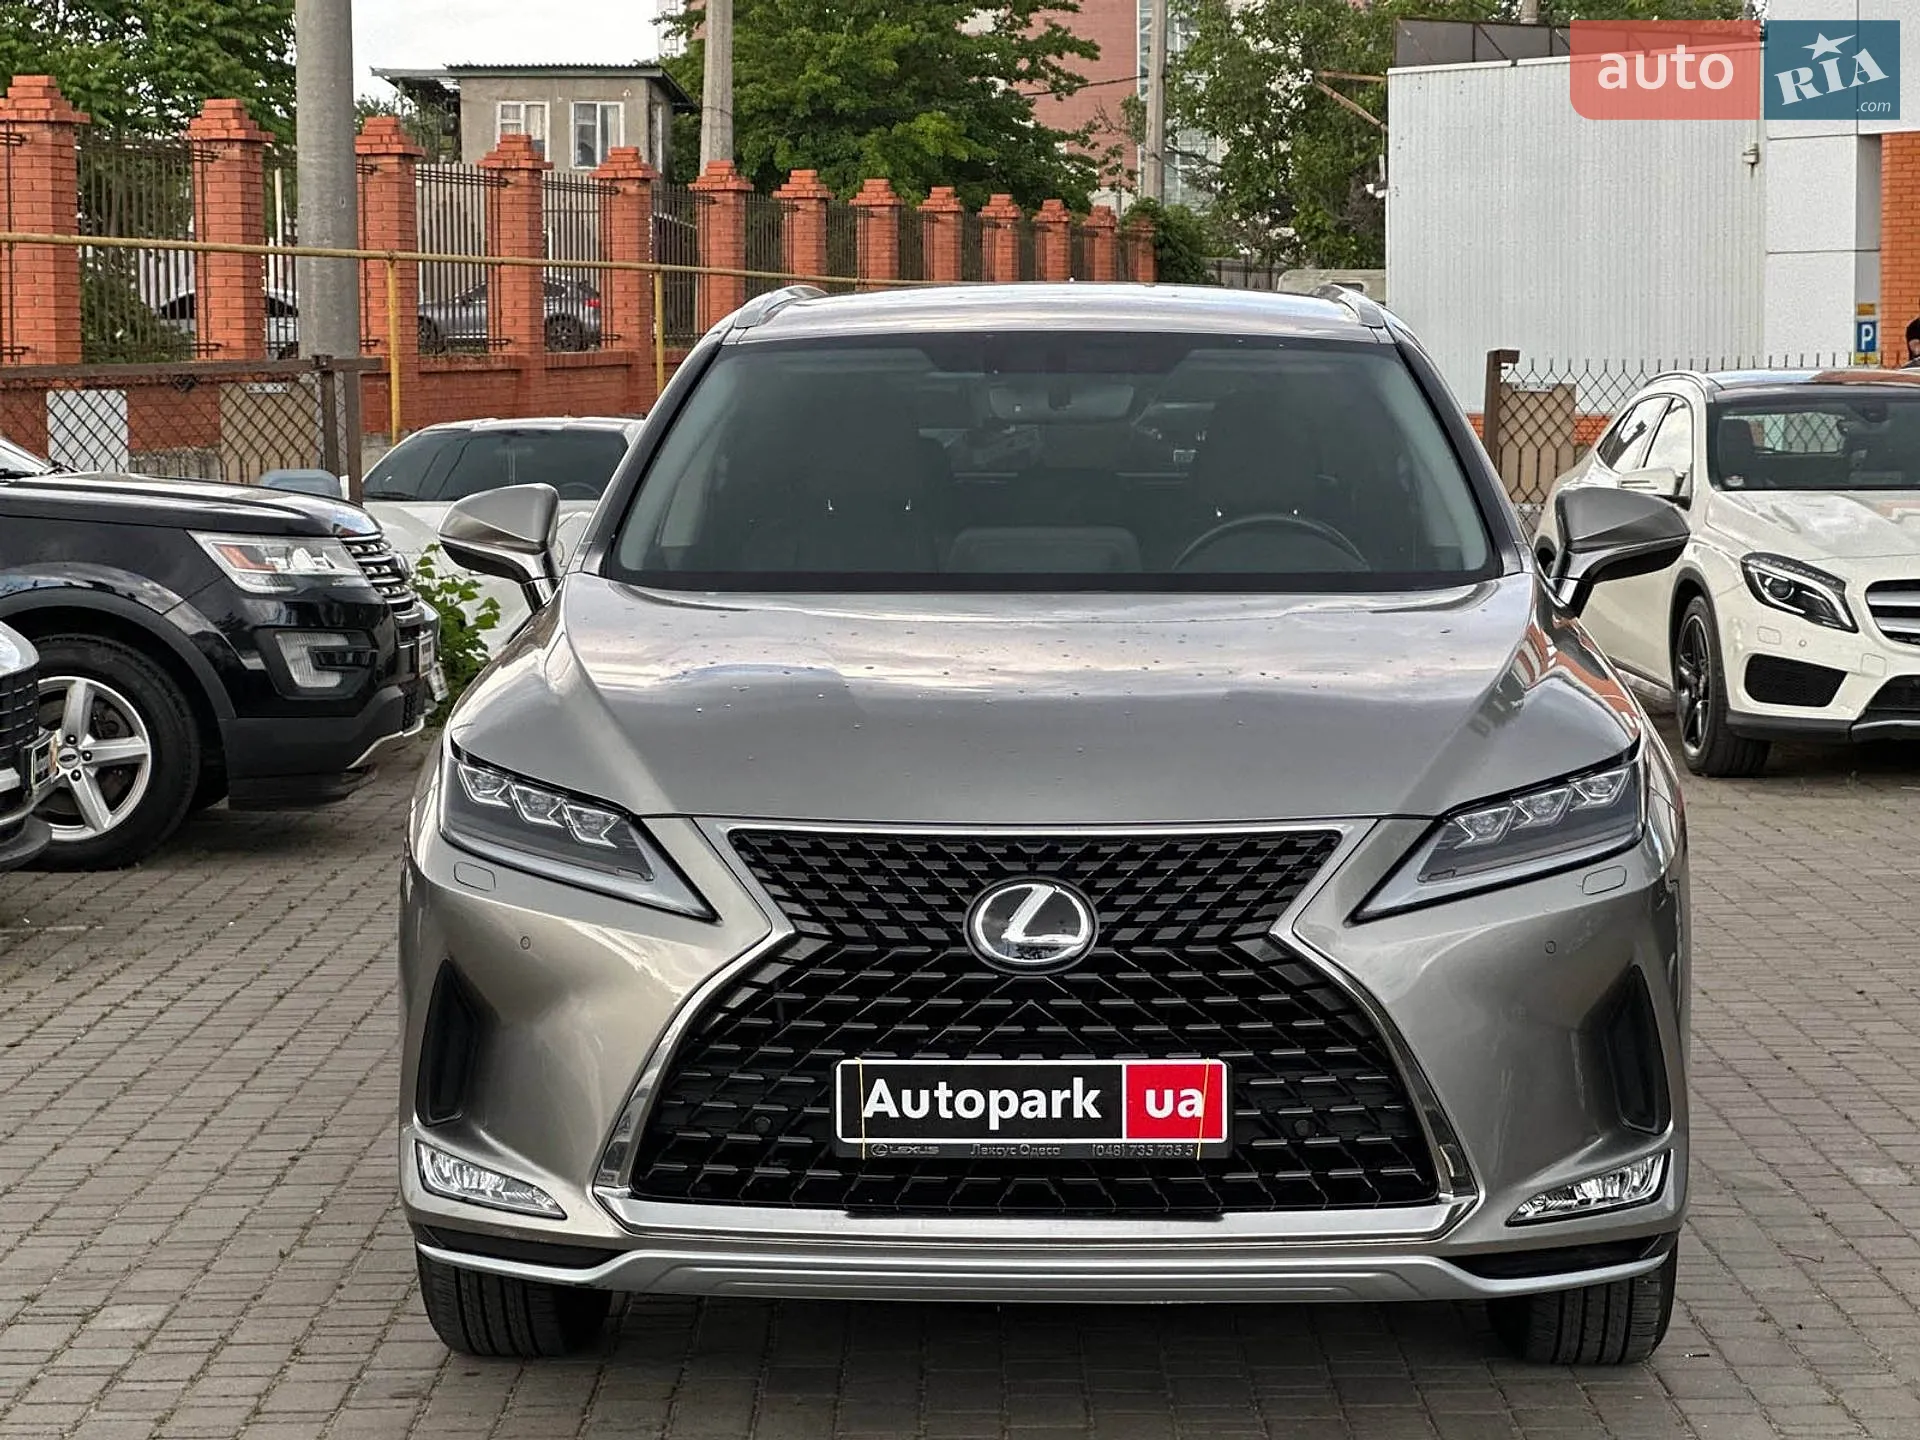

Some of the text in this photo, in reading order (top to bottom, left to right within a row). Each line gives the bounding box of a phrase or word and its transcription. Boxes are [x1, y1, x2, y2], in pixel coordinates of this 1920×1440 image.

[1861, 323, 1874, 351] P
[863, 1076, 1205, 1131] Autopark ua
